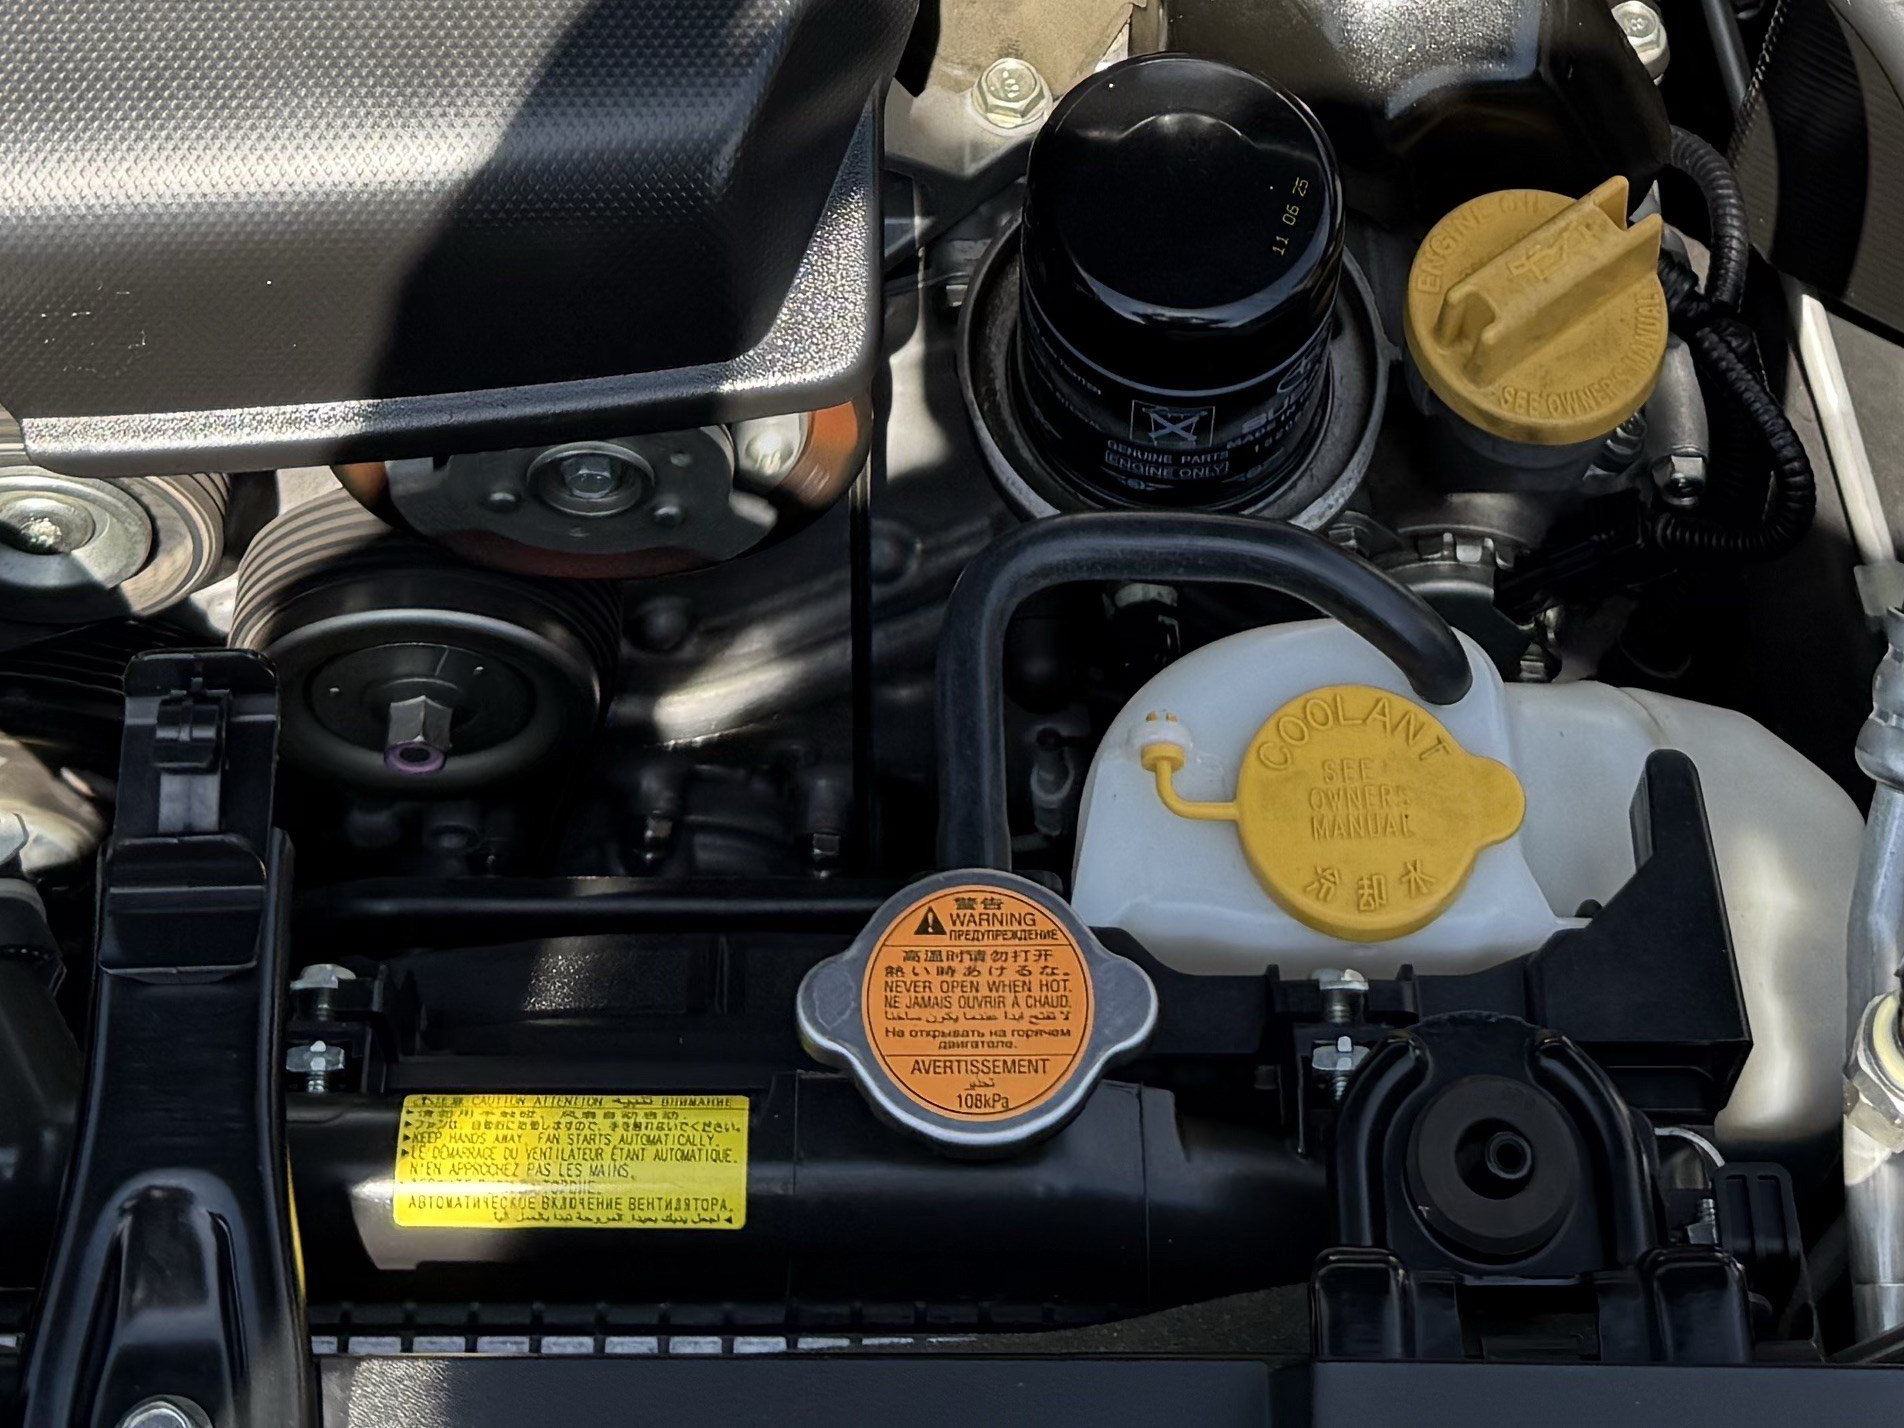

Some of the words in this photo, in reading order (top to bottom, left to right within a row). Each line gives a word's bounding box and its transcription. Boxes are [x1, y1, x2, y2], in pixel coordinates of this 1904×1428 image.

[1272, 235, 1289, 256] 11
[1282, 204, 1300, 226] 06
[1417, 206, 1492, 295] ENGINE
[1499, 385, 1542, 416] SEE
[1107, 440, 1173, 464] GENUINE
[1257, 692, 1452, 772] COOLANT
[1321, 757, 1376, 784] SEE
[1310, 813, 1412, 842] MANUAL
[1305, 858, 1440, 914] 冷却水
[954, 897, 1004, 910] 警告
[949, 912, 1037, 927] WARNING
[949, 929, 1059, 942] ПРЕДУПРЕЖДЕНИЕ
[884, 980, 932, 993] NEVER
[939, 980, 980, 993] OPEN
[986, 980, 1032, 993] WHEN
[1039, 979, 1073, 993] HOT.
[884, 995, 899, 1009] NE
[905, 995, 952, 1009] JAMAIS
[958, 995, 1007, 1009] OUVRIR
[910, 1058, 1050, 1075] AVERTISSEMENT
[957, 1093, 1010, 1109] 108kPa
[412, 1132, 441, 1143] KEEP
[449, 1133, 486, 1144] HANDS
[537, 1133, 560, 1144] FAN
[567, 1134, 611, 1145] STARTS
[411, 1146, 426, 1159] LE
[503, 1147, 518, 1159] DU
[525, 1147, 603, 1161] VENTILATEUR
[526, 1163, 551, 1177] PAS
[559, 1163, 582, 1177] LES
